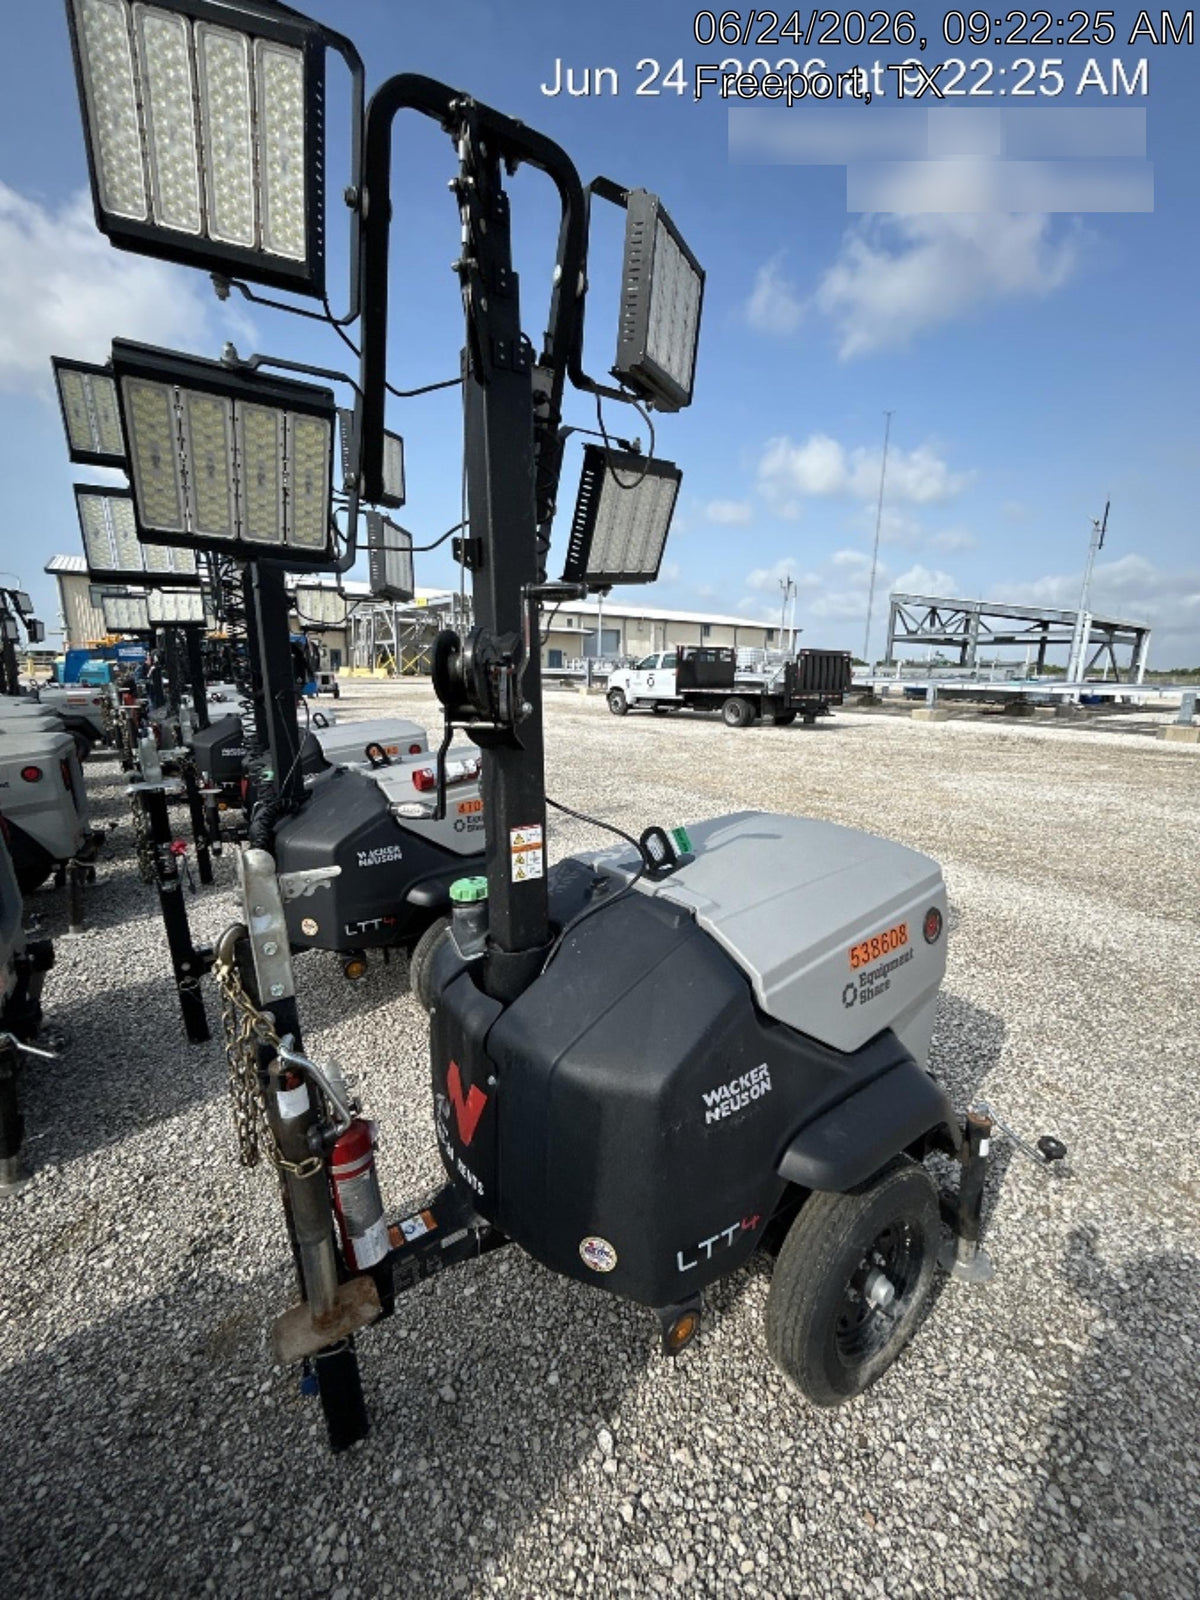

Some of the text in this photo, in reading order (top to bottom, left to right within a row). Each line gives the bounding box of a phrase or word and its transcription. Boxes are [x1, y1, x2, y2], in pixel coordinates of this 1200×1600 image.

[850, 923, 908, 969] 538608
[859, 947, 914, 987] Equipment
[859, 978, 892, 1005] Share
[702, 1062, 770, 1107] WACKER
[705, 1077, 773, 1125] NEUSON
[677, 1215, 760, 1272] LTT4
